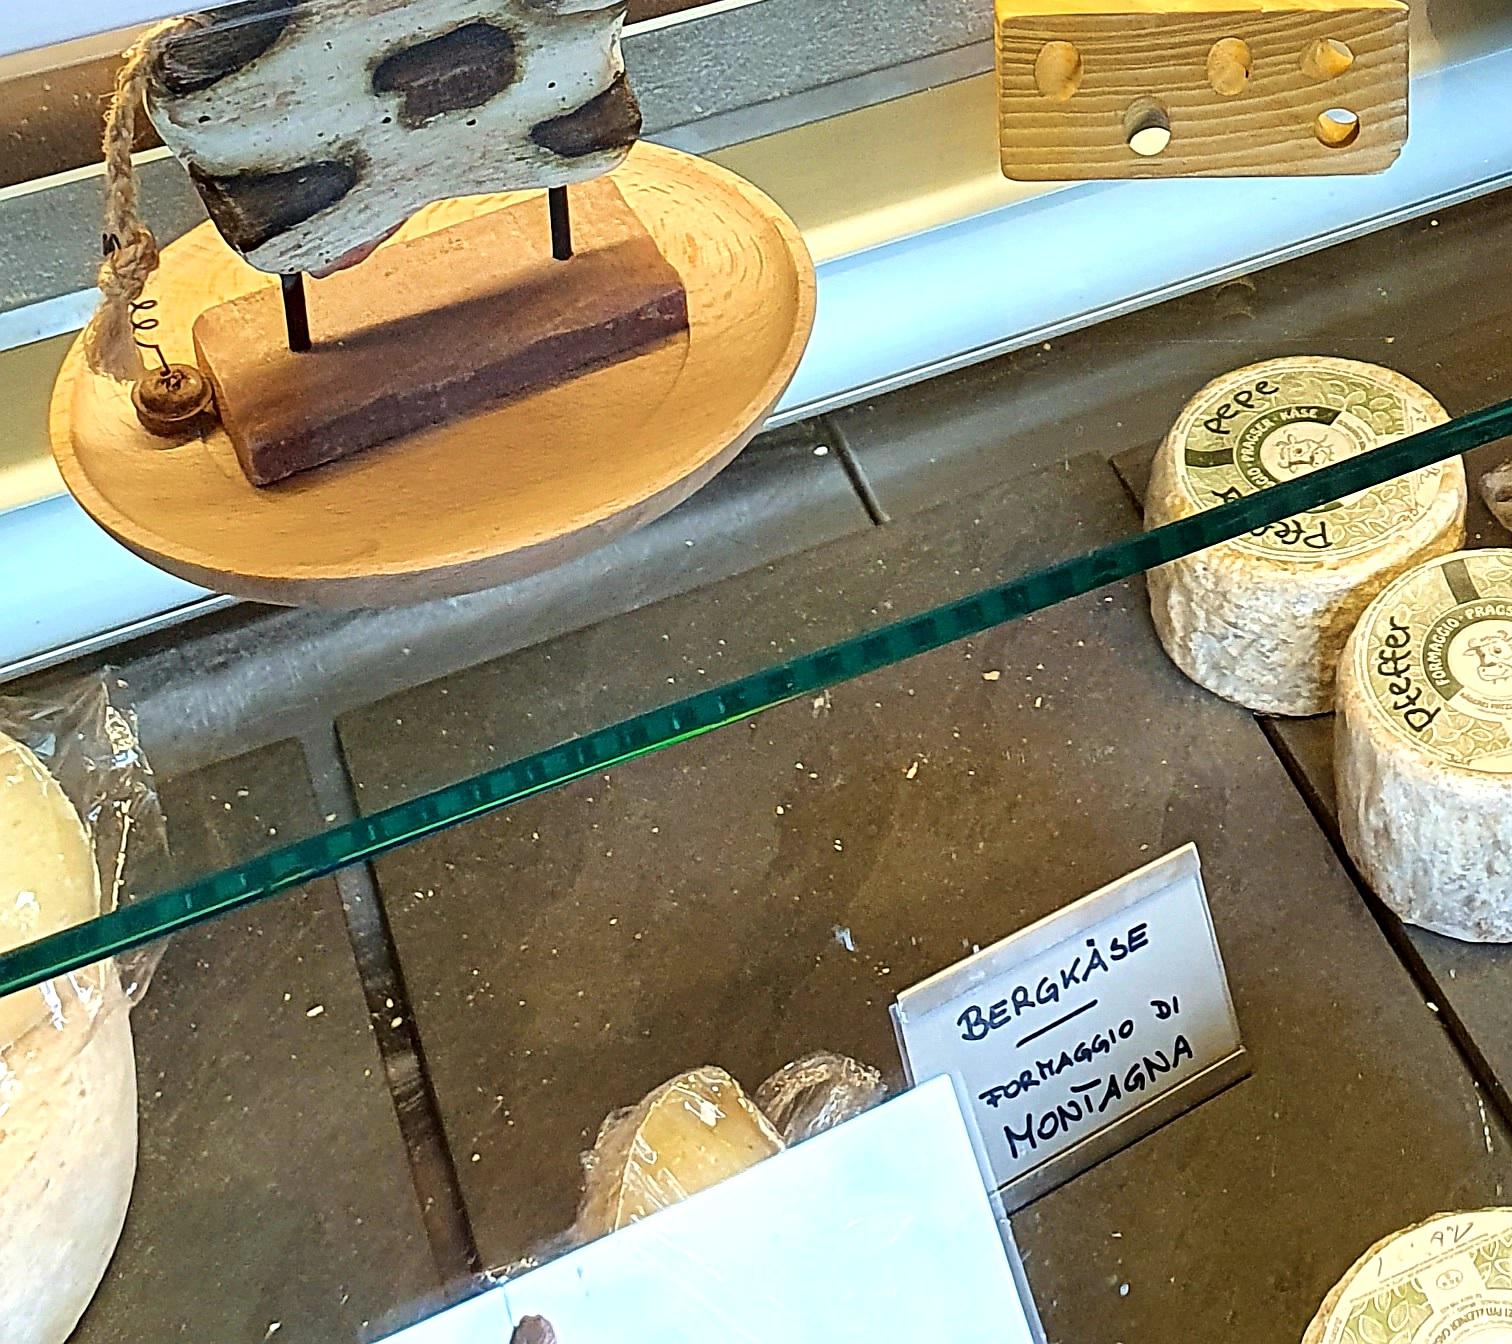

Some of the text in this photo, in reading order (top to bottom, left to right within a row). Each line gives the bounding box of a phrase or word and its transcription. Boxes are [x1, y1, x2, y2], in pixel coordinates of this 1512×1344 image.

[1279, 406, 1319, 420] KÄSE
[1427, 618, 1460, 687] FORMAGGIO
[956, 922, 1150, 1042] BERGKÄSE
[978, 995, 1180, 1108] FORMAGGIO DI
[1002, 1034, 1194, 1160] MONTAGNA
